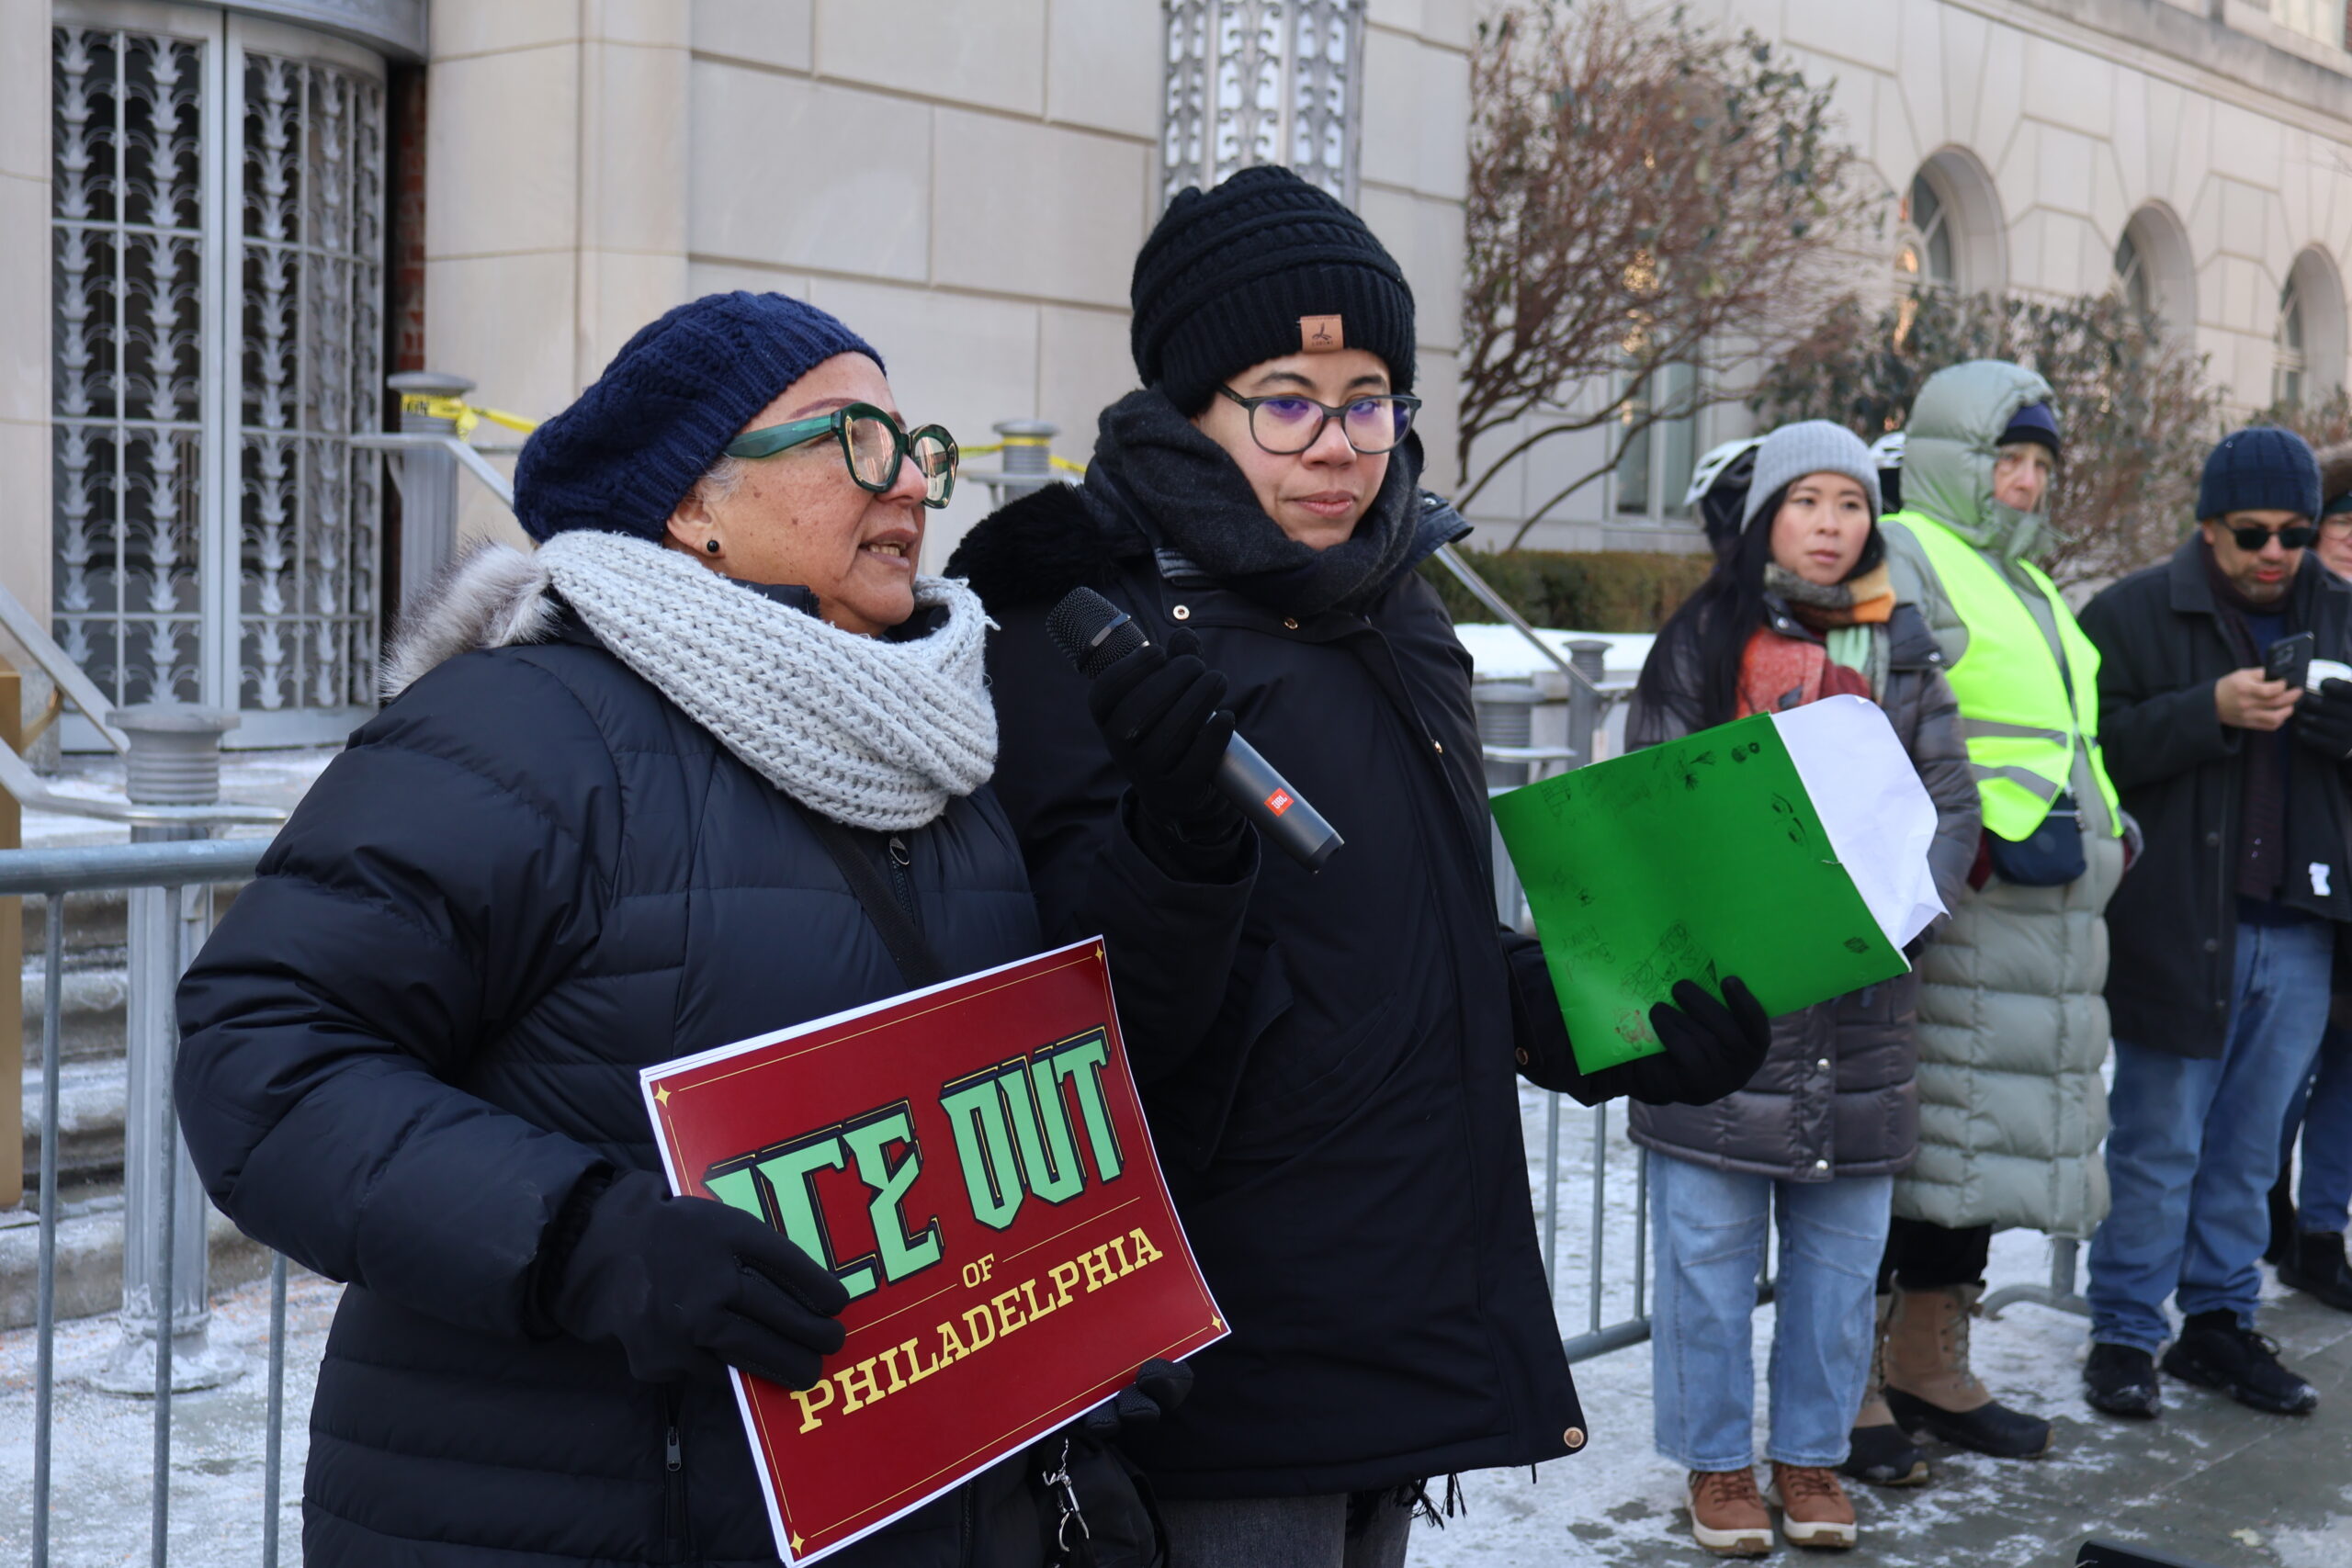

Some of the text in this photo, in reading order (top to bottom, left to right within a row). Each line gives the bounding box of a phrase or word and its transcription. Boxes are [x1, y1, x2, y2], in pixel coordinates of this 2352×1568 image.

[1271, 795, 1288, 809] JBL
[938, 1024, 1125, 1230] OUT
[789, 1227, 1163, 1434] PHILADELPHIA
[962, 1253, 995, 1289] OF
